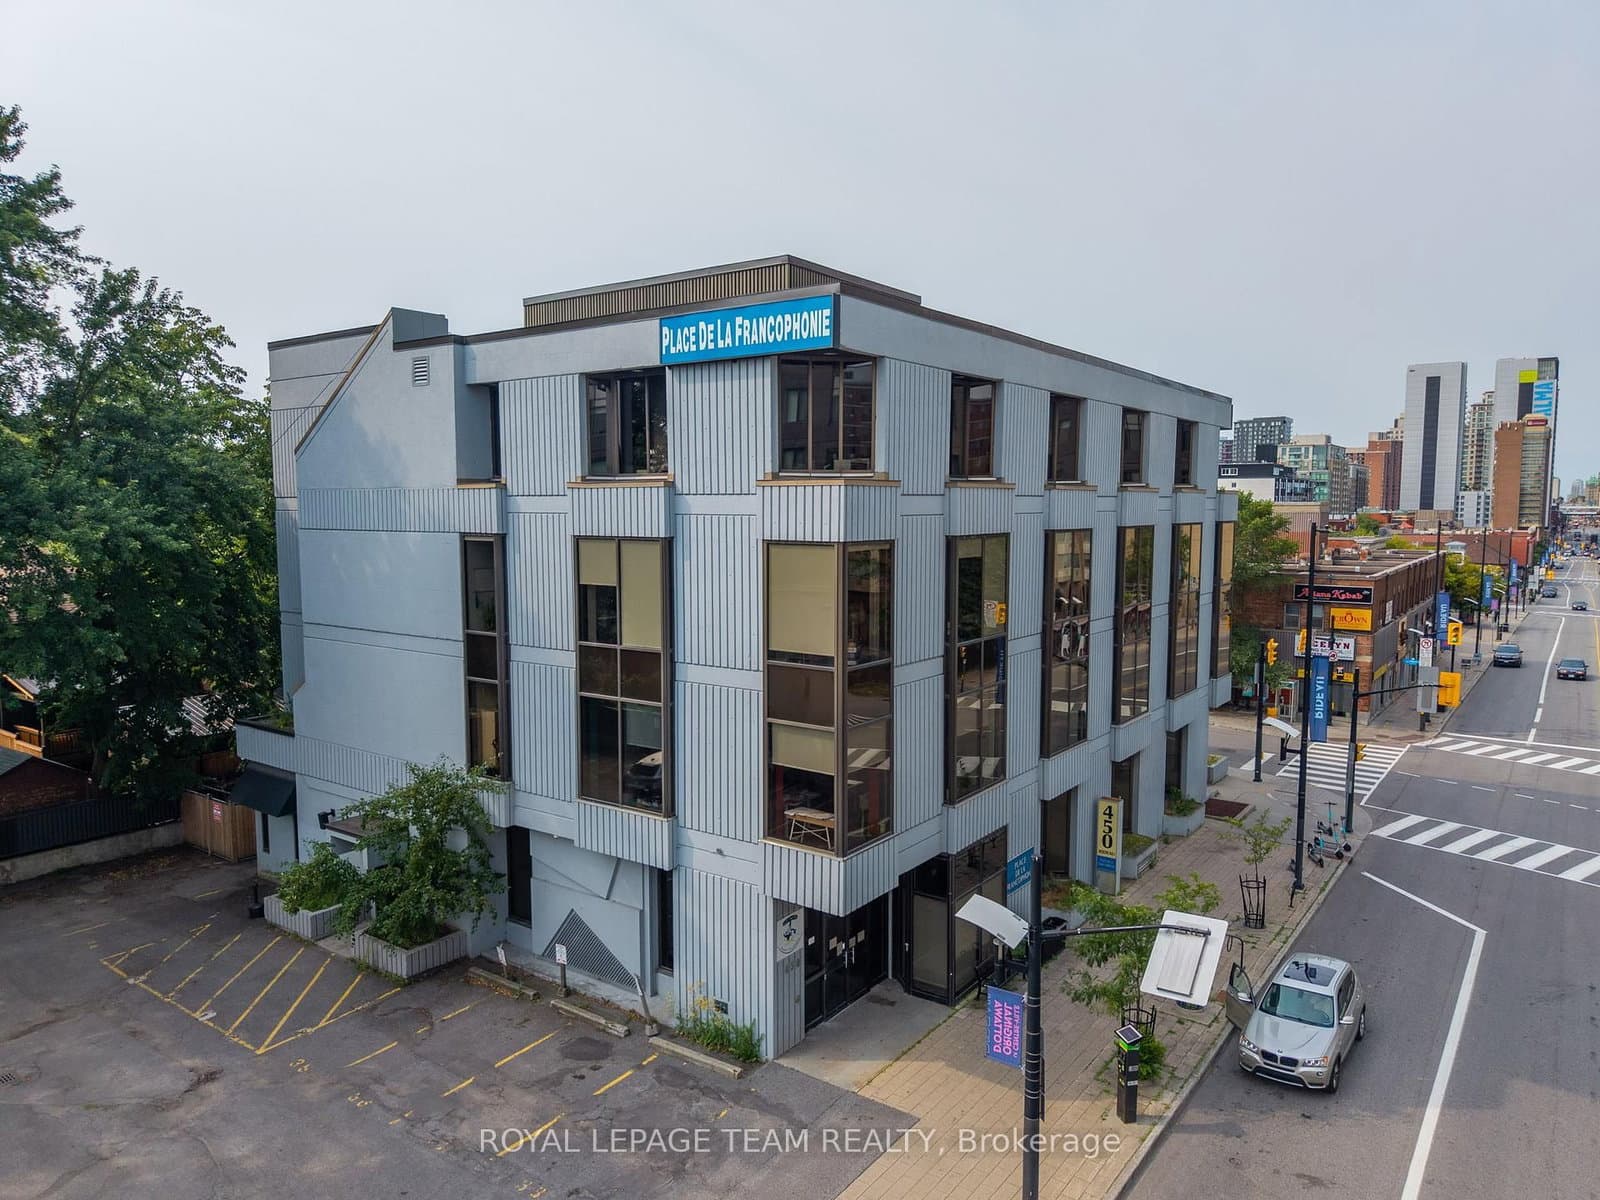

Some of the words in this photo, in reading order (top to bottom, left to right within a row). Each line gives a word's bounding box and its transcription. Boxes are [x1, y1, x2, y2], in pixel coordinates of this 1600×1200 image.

[662, 326, 696, 355] PLACE
[699, 321, 714, 351] DE
[717, 318, 732, 349] LA
[735, 308, 831, 347] FRANCOPHONIE
[1102, 805, 1114, 849] 450
